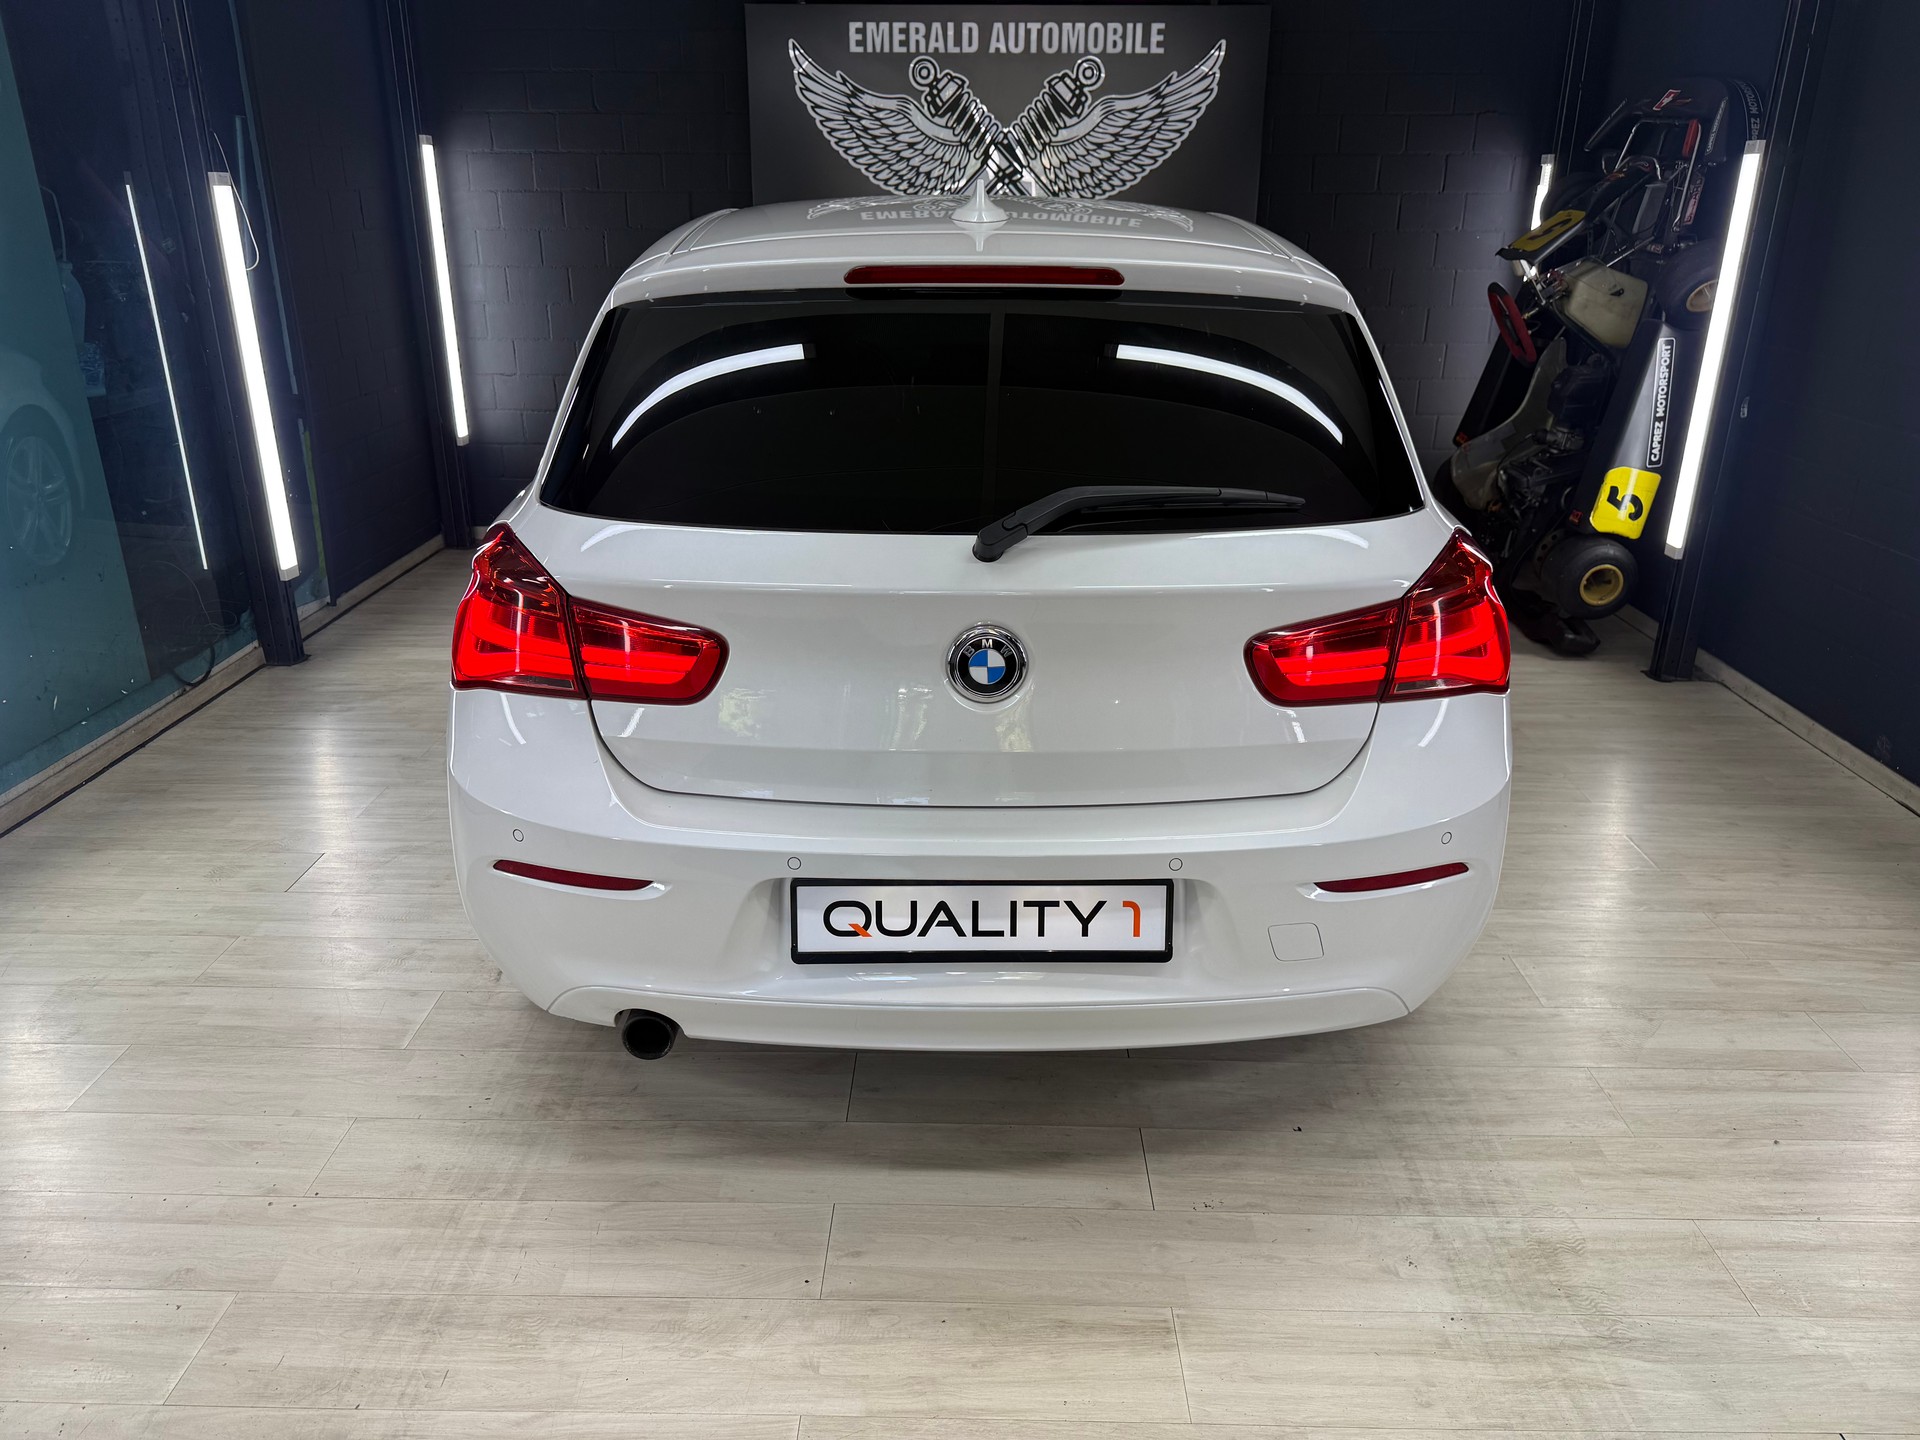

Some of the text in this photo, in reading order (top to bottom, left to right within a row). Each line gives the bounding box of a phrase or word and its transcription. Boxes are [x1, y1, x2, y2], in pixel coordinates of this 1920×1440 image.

[848, 21, 1166, 55] EMERALD AUTOMOBILE
[1750, 116, 1760, 141] PREZ
[1650, 343, 1672, 462] CAPREZ MOTORSPORT
[1606, 483, 1644, 522] 5
[962, 638, 1013, 658] BMW
[822, 899, 1108, 938] QUALITY
